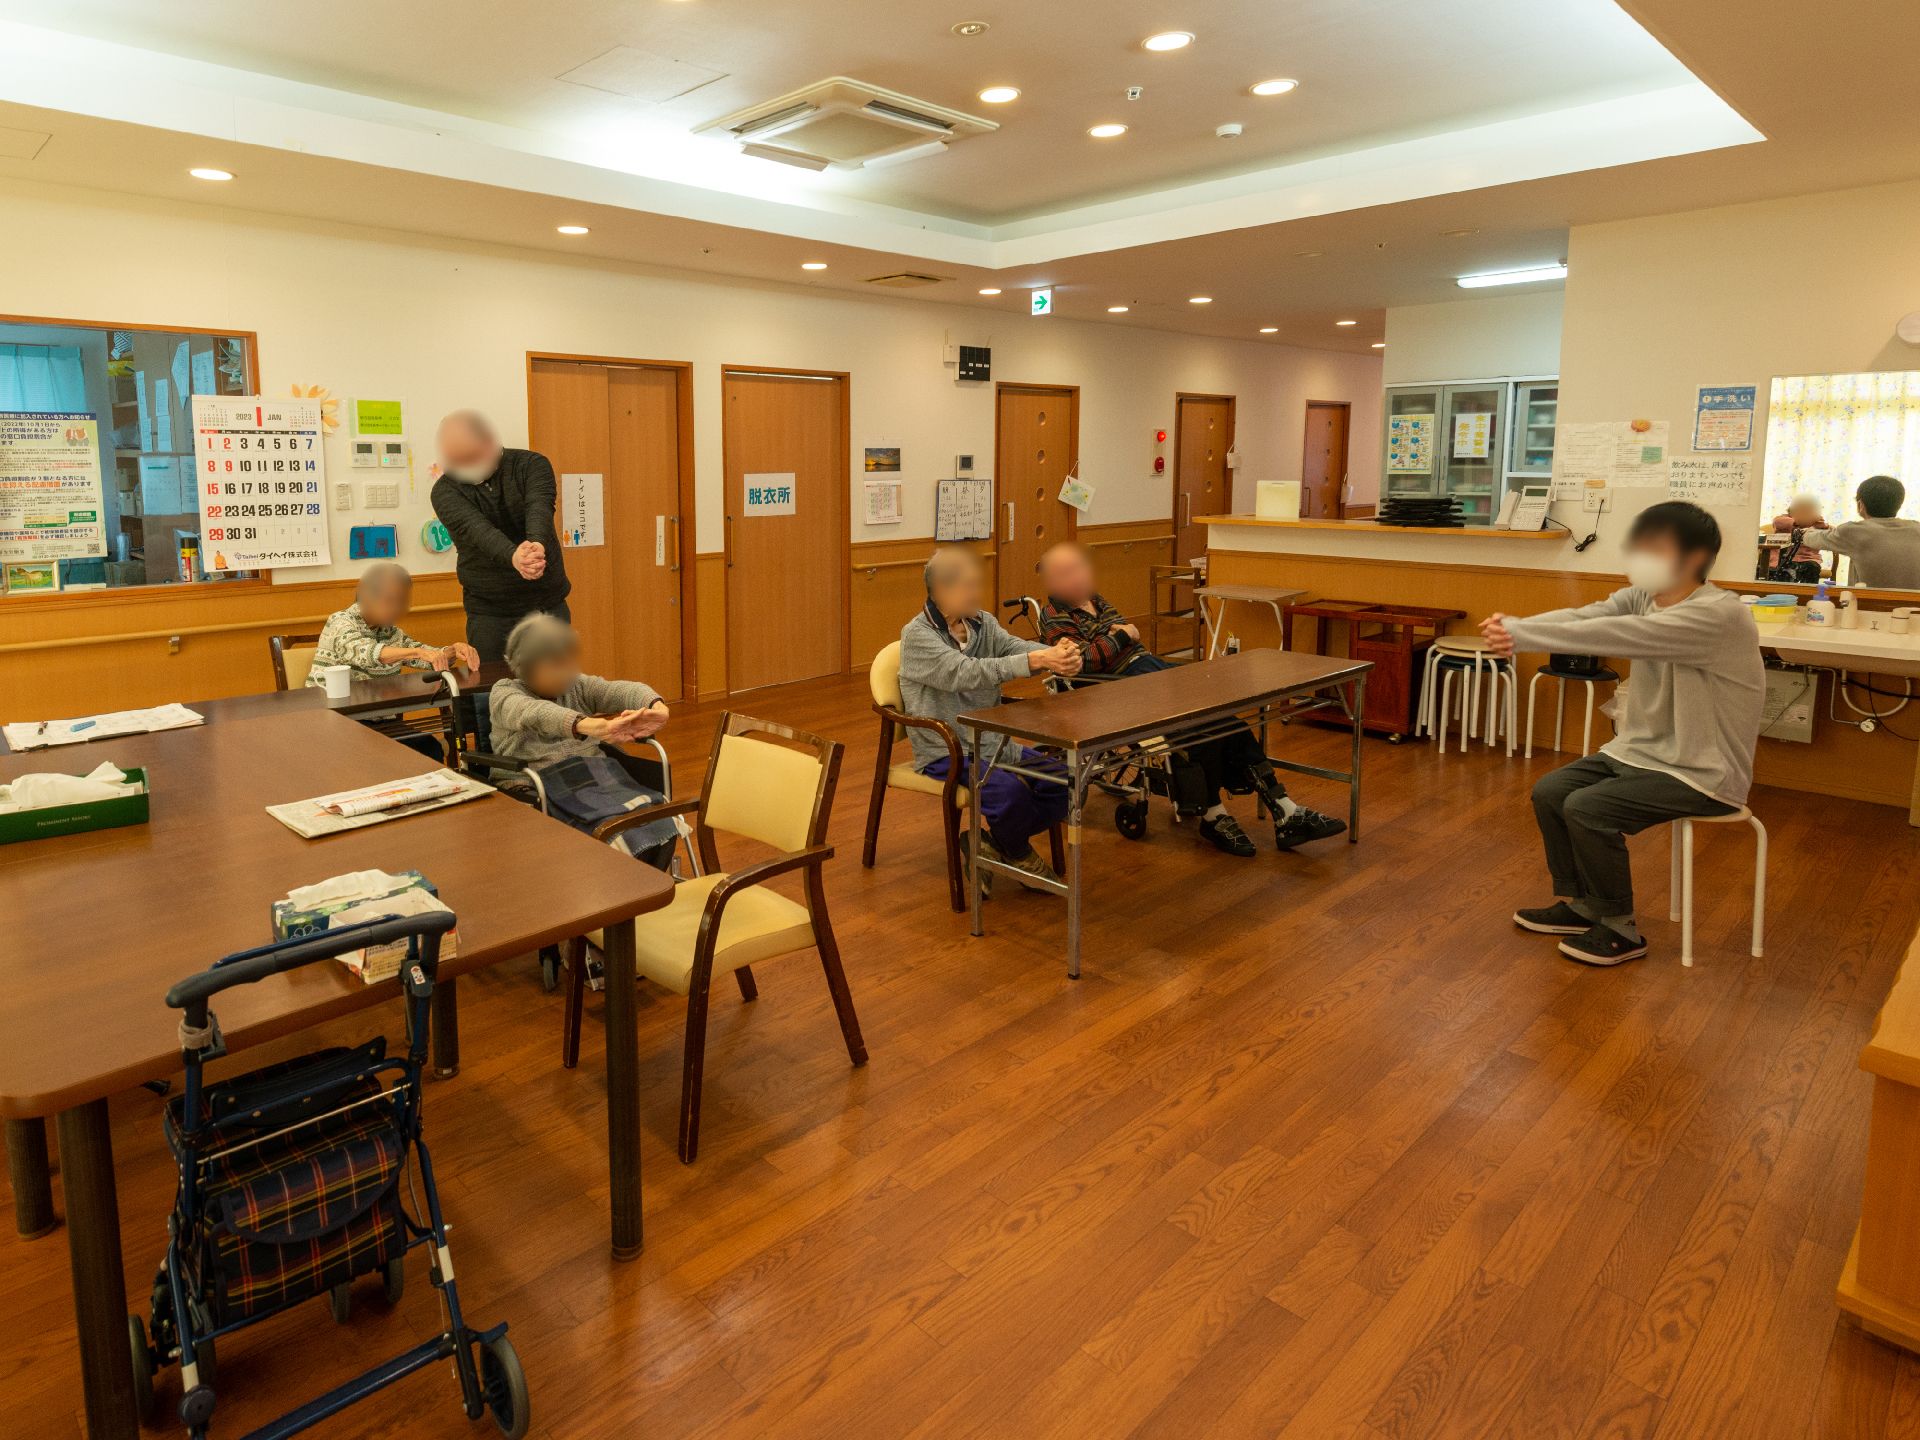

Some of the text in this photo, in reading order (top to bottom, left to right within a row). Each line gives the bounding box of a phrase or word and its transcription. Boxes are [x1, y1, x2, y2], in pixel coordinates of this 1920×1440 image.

[1713, 394, 1751, 403] 手洗い
[236, 413, 252, 421] 2023
[267, 413, 282, 421] JAN
[207, 437, 313, 449] 1 2 3 4 5 6 7
[207, 460, 315, 472] 8 9 10 11 12 13 14
[207, 482, 317, 495] 15 16 17 18 19 20 21
[749, 487, 790, 504] 脱衣所
[207, 504, 320, 517] 22 23 24 25 26 27 28
[209, 528, 224, 540] 29
[226, 528, 240, 539] 30
[245, 527, 256, 539] 31
[431, 525, 452, 551] 18
[259, 551, 318, 560] タイヘイ株式会社
